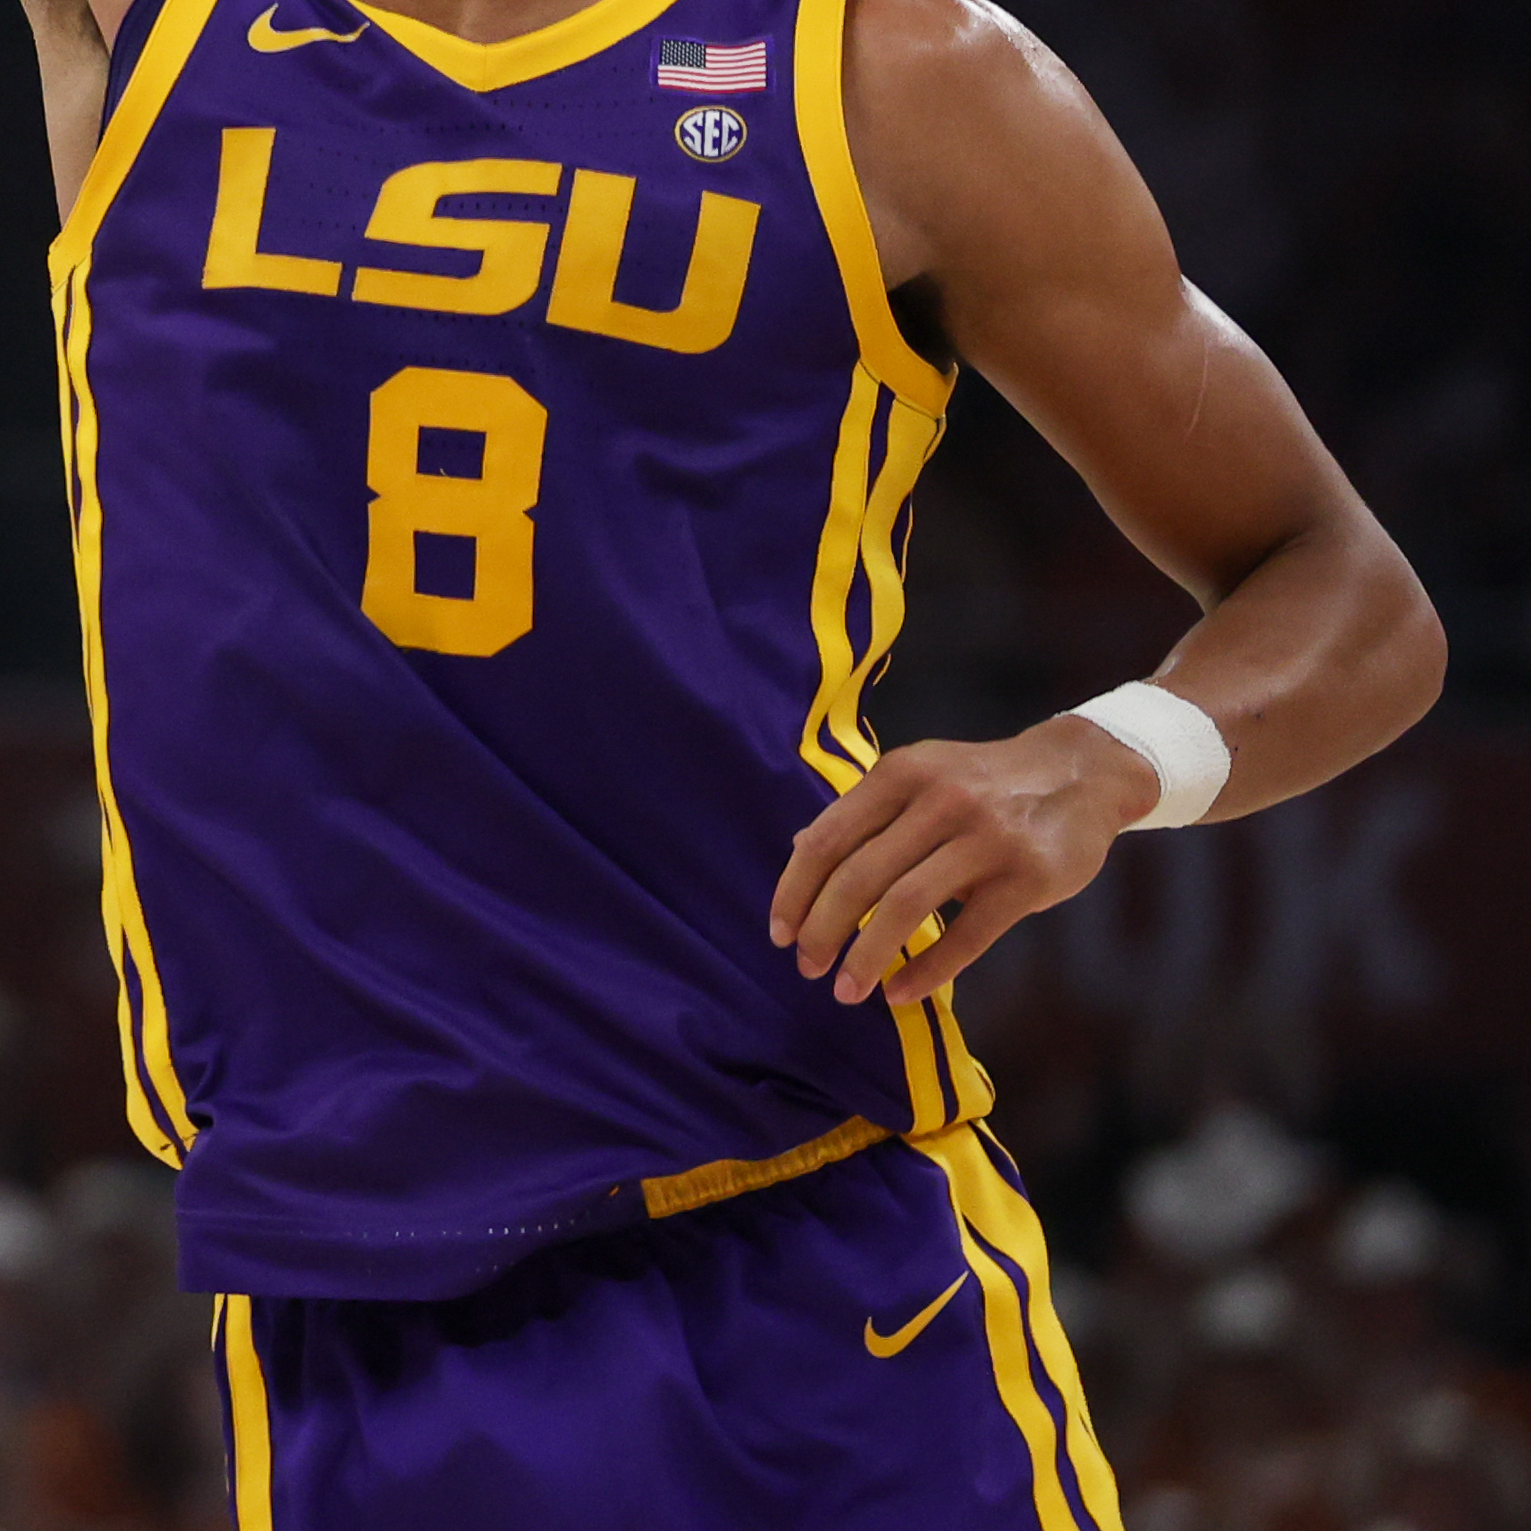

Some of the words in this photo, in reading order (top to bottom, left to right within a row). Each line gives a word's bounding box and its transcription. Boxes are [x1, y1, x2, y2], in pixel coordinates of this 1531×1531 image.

[201, 126, 762, 355] LSU
[683, 110, 740, 157] SEC
[360, 366, 548, 658] 8
